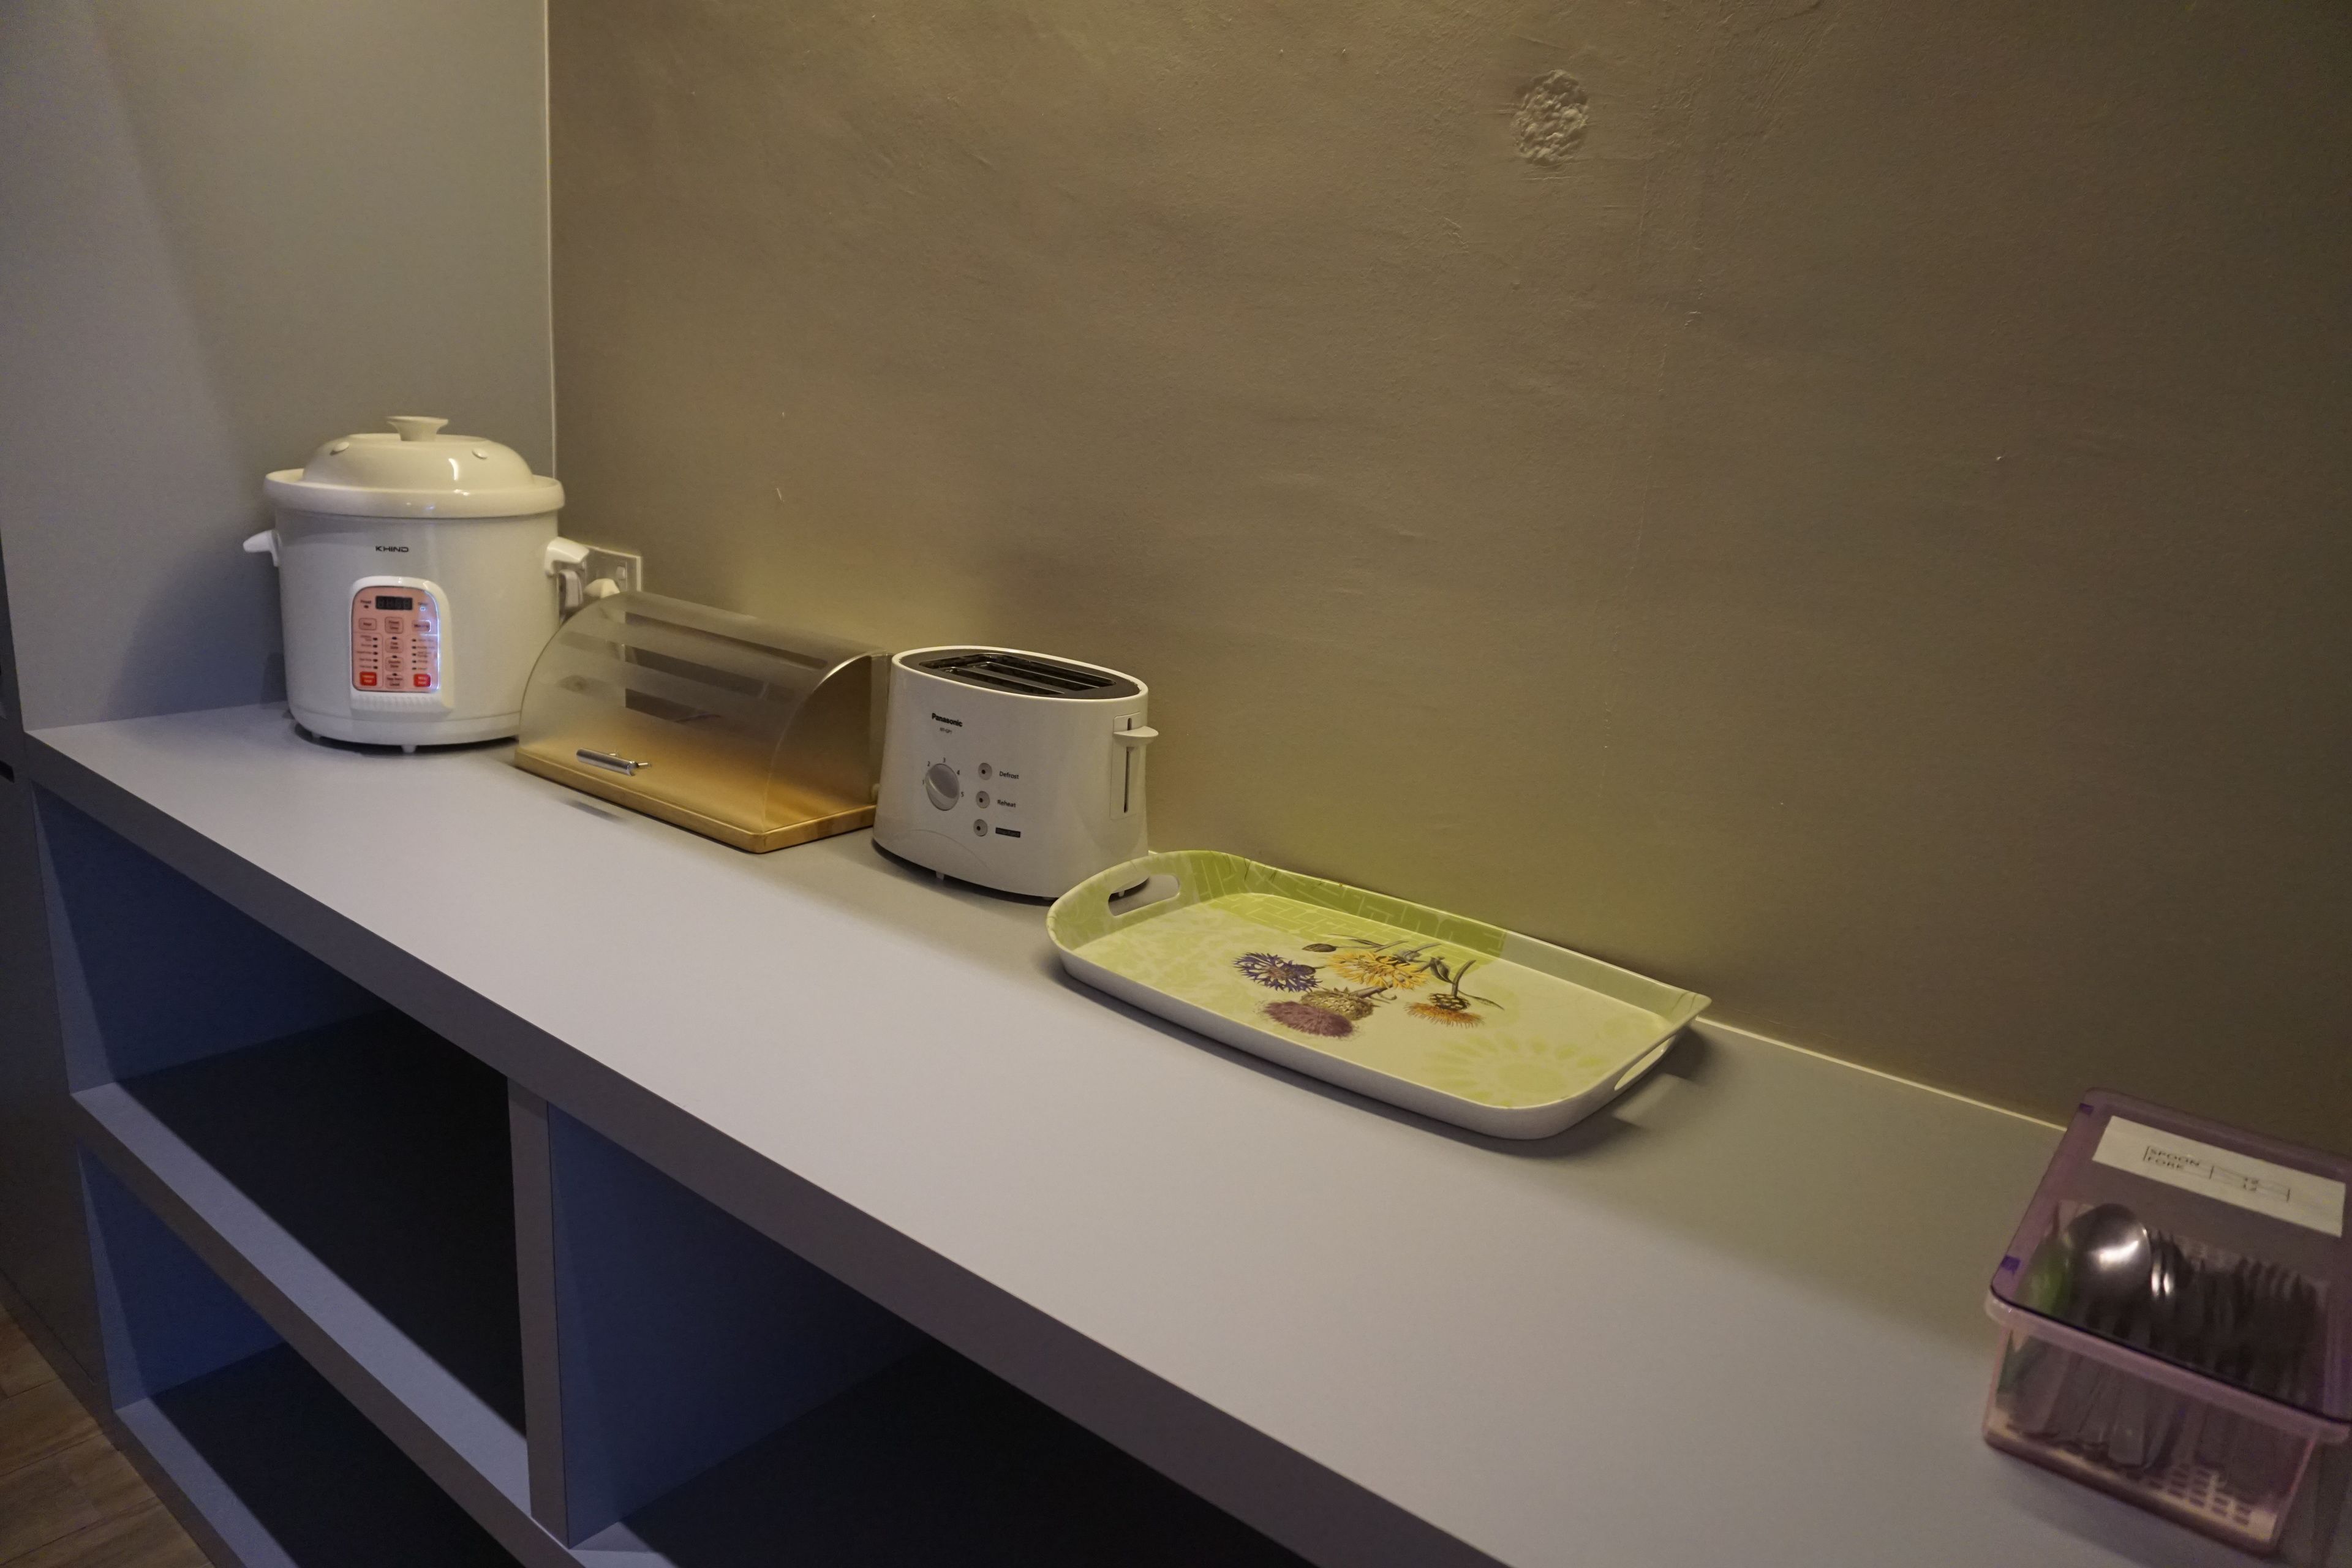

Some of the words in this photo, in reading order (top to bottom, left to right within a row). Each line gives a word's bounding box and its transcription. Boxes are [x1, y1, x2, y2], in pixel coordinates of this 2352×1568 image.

[932, 712, 962, 727] Panasonic
[1000, 771, 1019, 780] Defrost
[997, 799, 1017, 808] Reheat
[2147, 1156, 2184, 1169] FORK
[2150, 1148, 2200, 1166] SPOON
